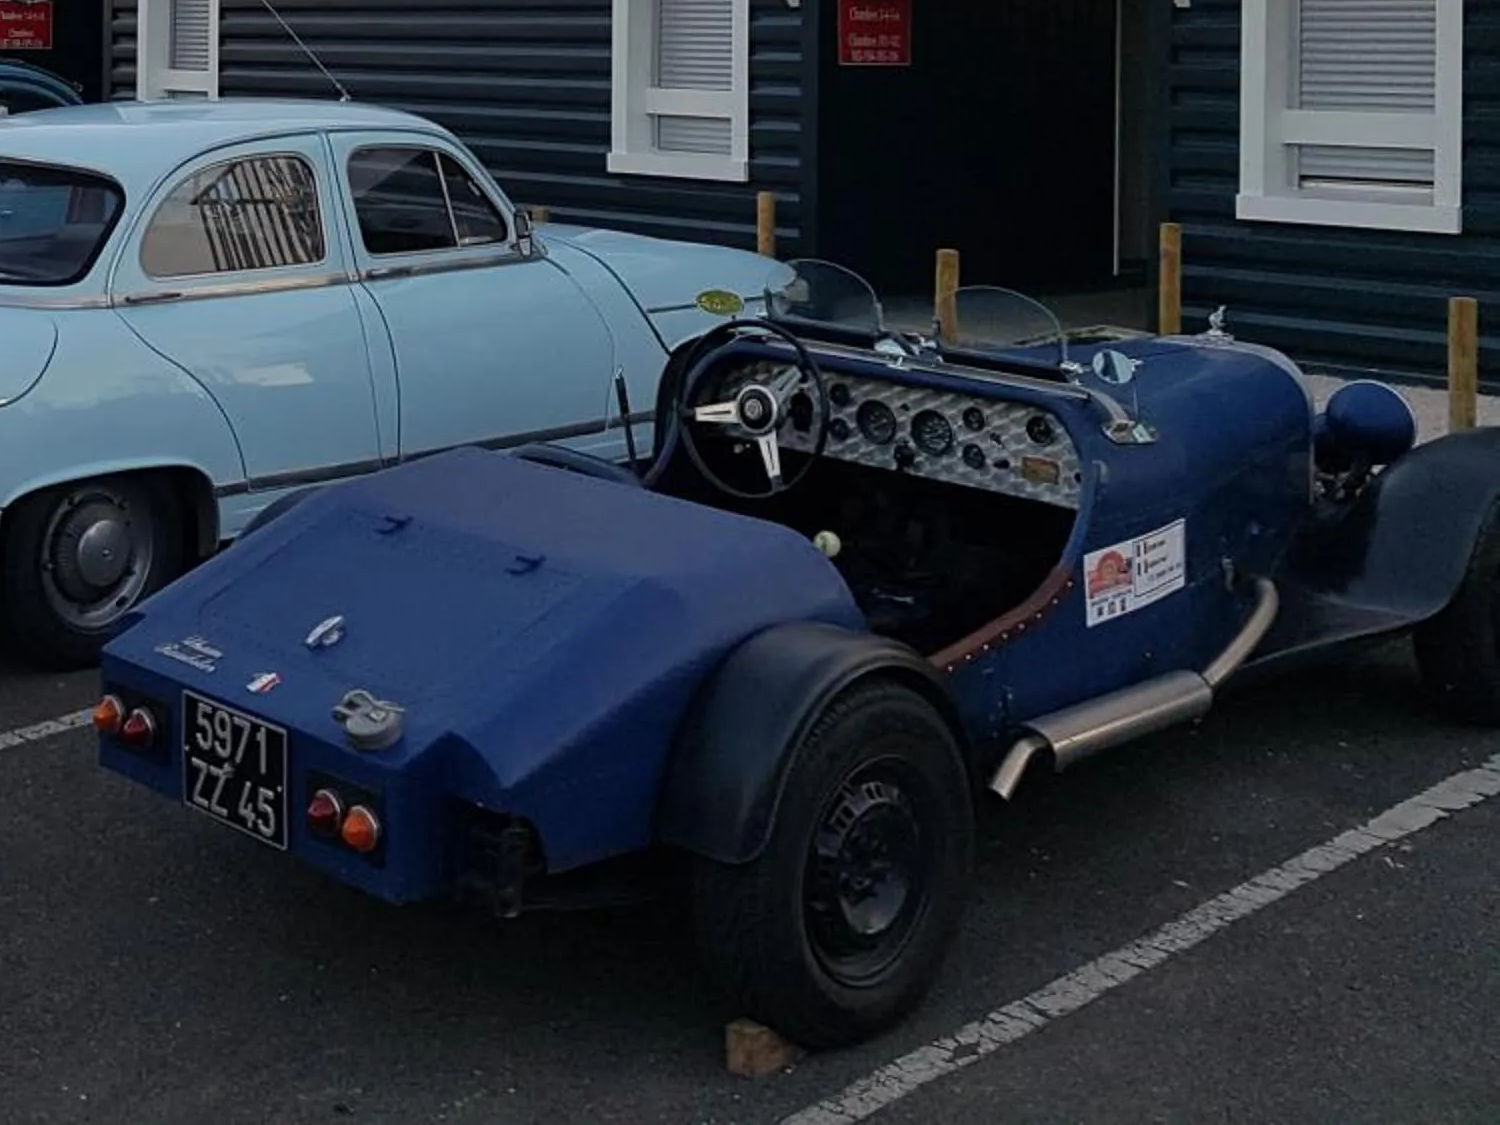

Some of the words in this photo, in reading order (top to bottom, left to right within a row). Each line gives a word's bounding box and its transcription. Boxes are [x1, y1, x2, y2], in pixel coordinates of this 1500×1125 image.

[196, 702, 267, 775] 5971
[191, 757, 234, 817] ZZ
[238, 781, 275, 837] 45
